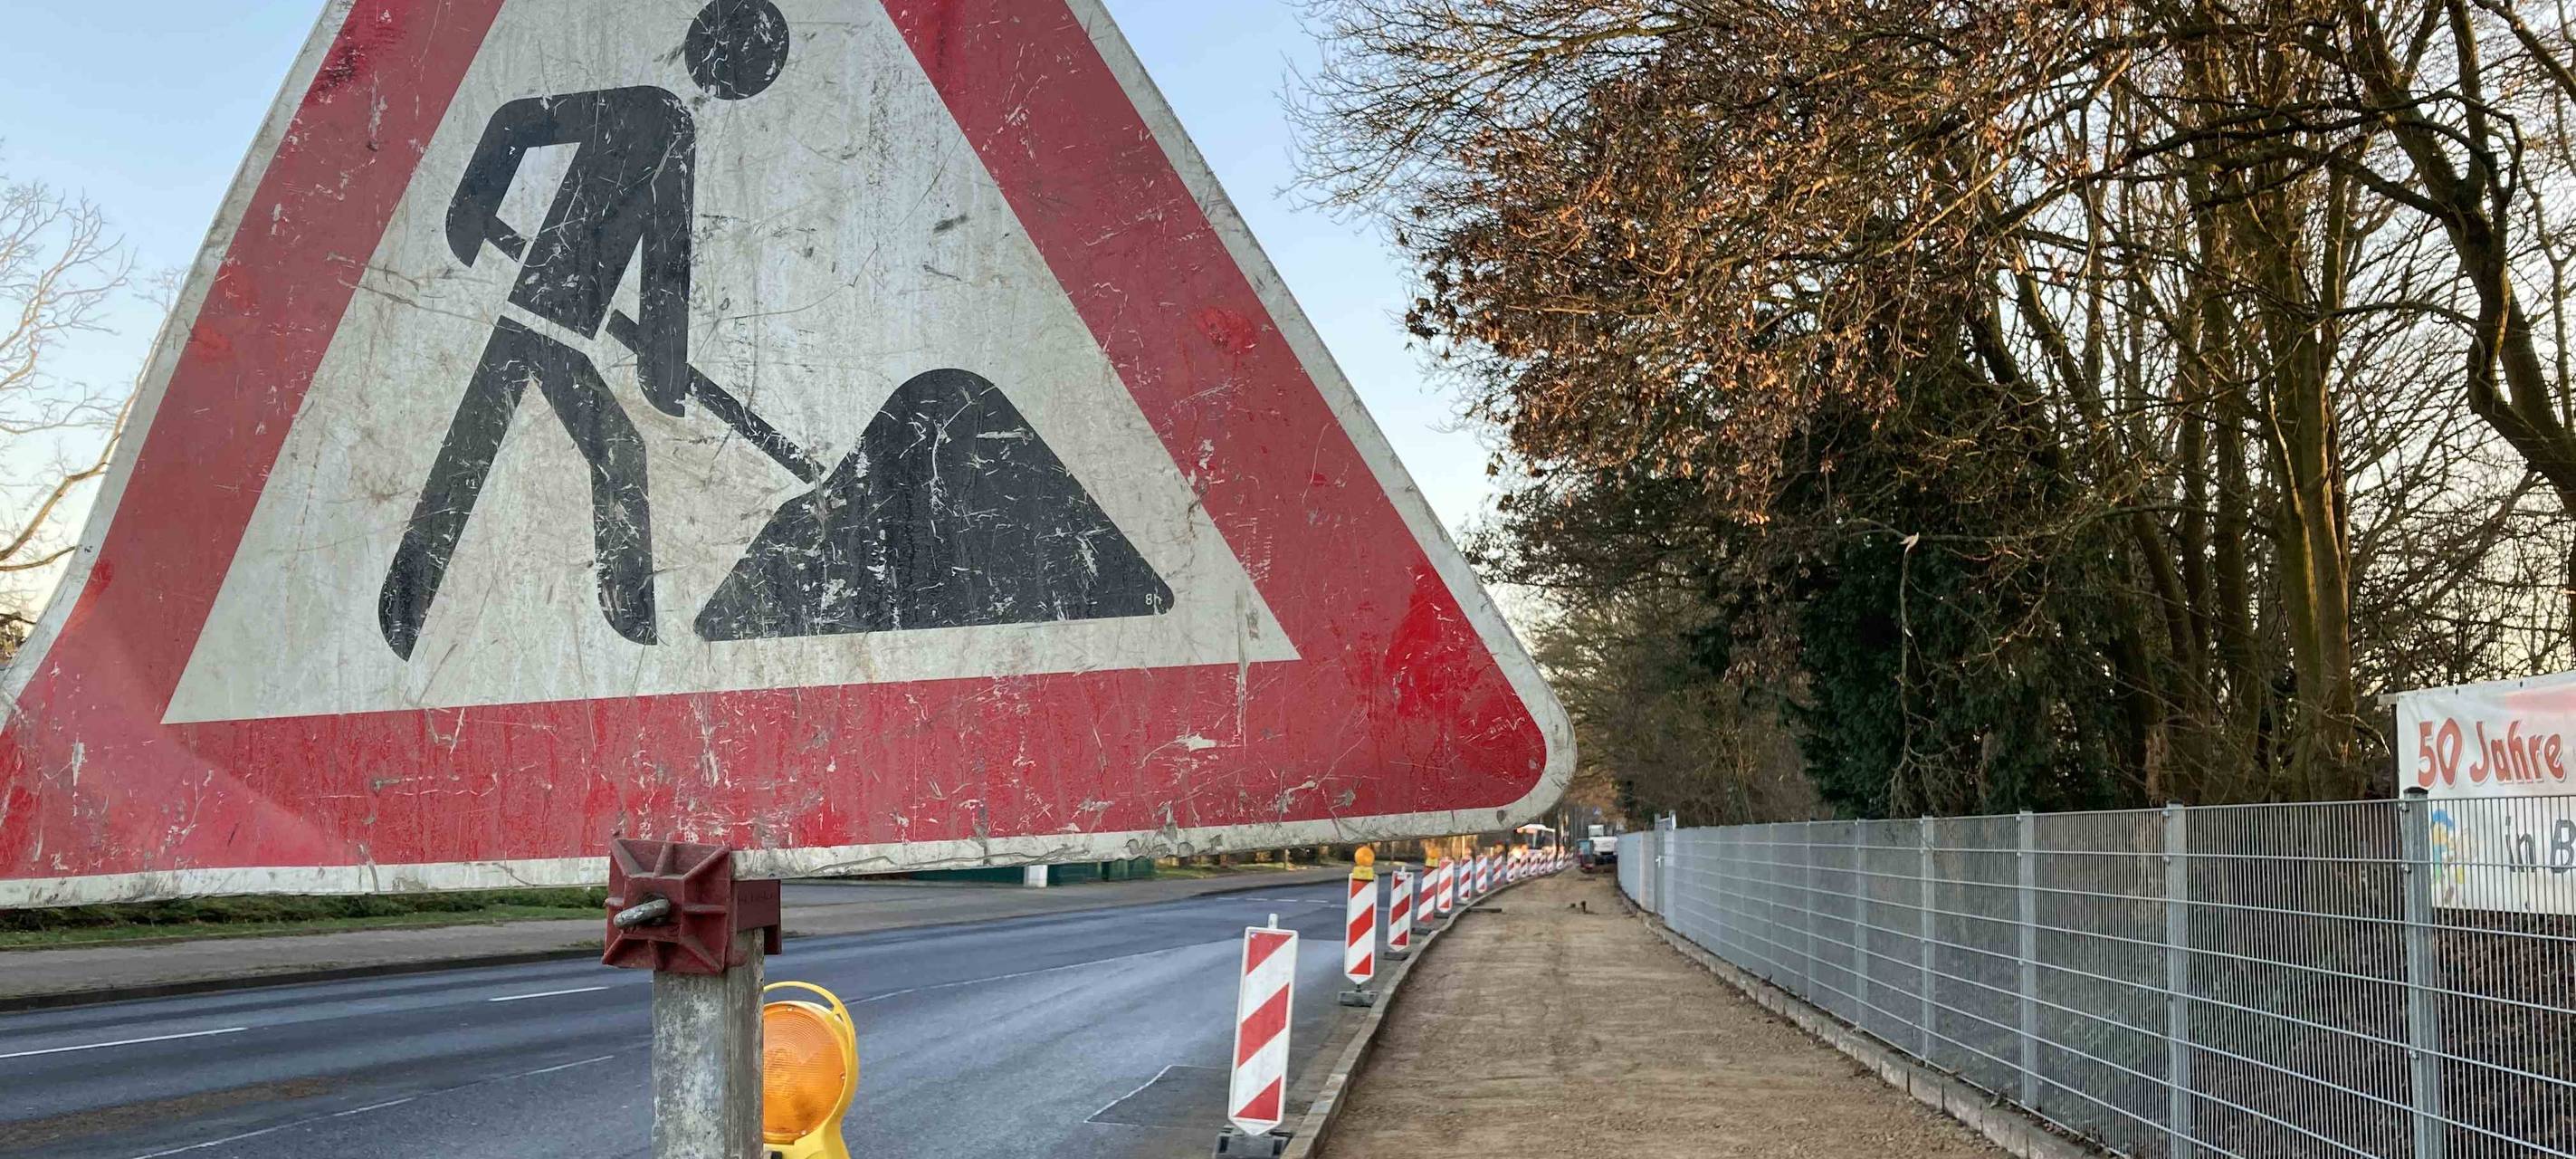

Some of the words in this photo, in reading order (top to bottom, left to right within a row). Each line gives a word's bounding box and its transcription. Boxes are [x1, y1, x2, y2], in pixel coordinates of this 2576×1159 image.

[2417, 717, 2462, 789] 50
[2469, 720, 2567, 783] Jahre
[2504, 815, 2535, 873] in
